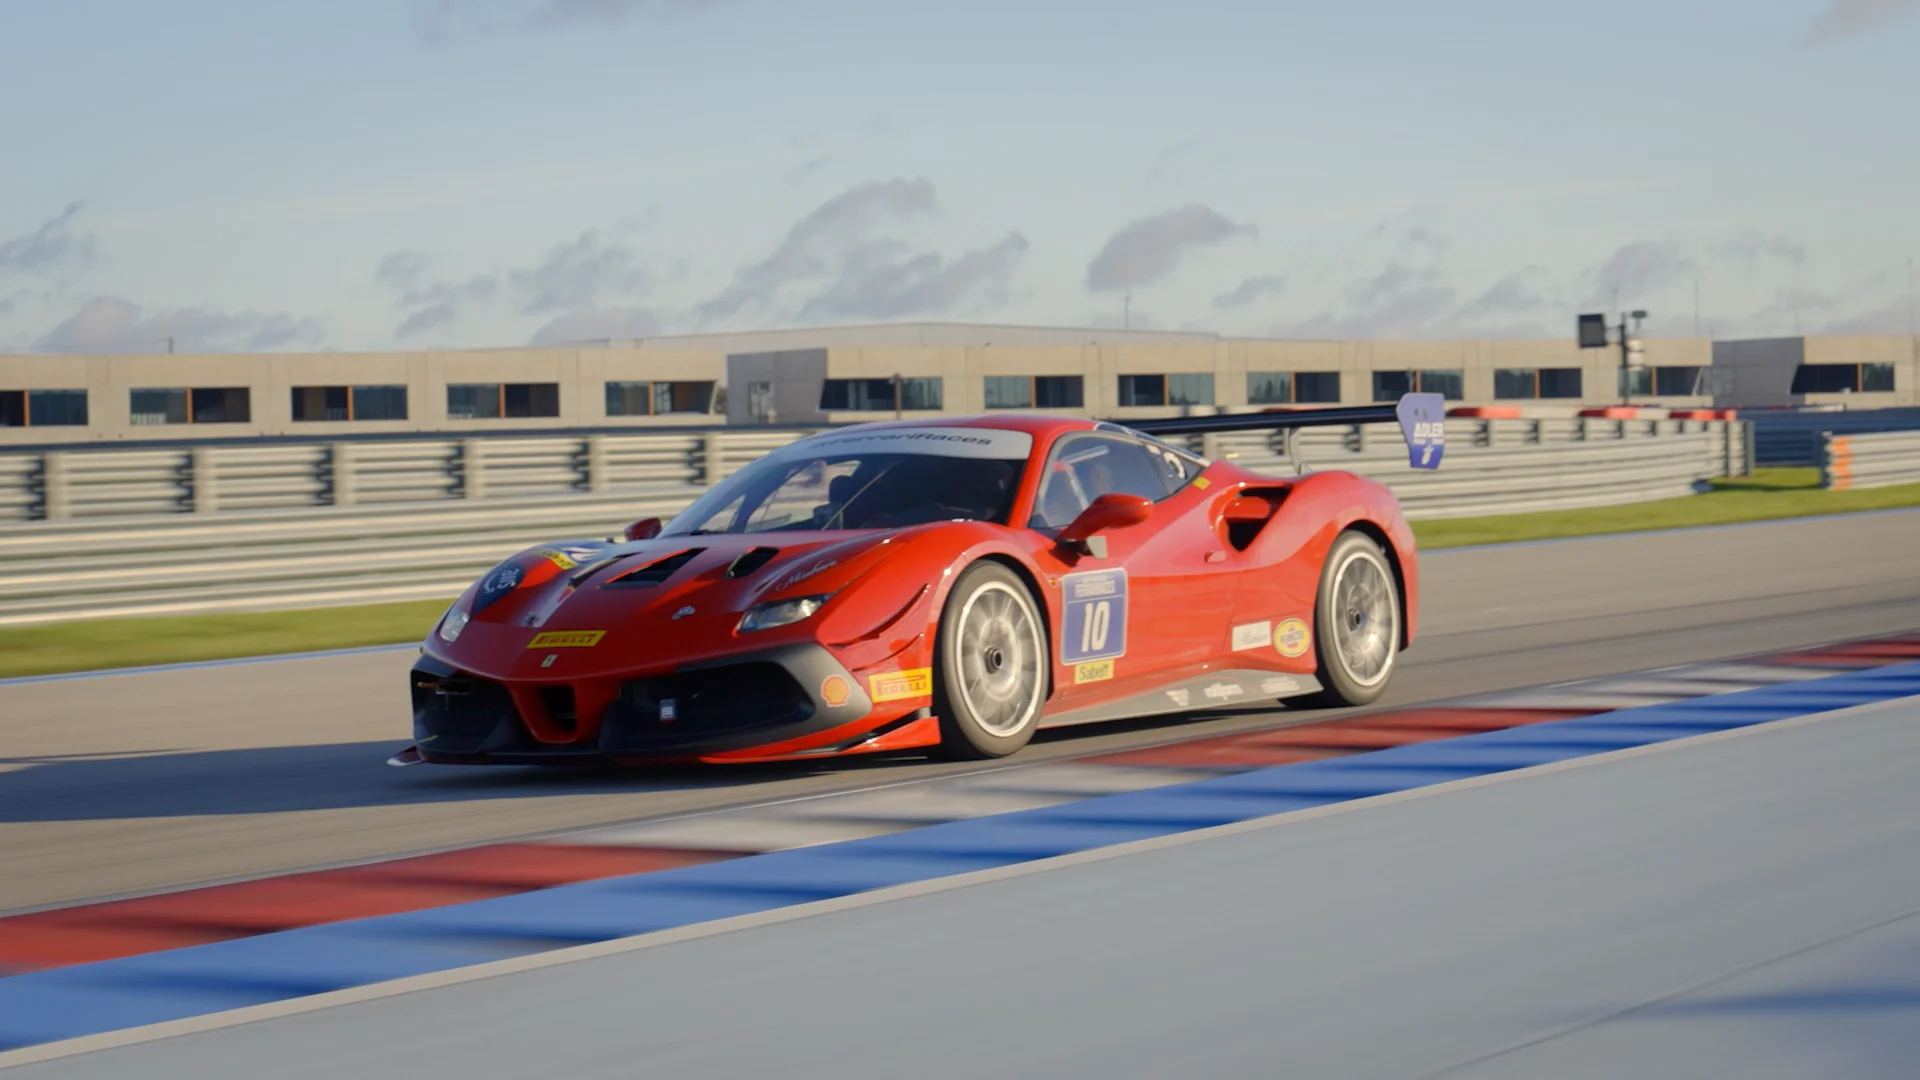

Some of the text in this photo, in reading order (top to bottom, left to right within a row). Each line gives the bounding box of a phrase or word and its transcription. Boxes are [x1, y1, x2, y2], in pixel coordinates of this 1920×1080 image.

[1081, 600, 1110, 653] 10
[535, 633, 598, 645] PIRELLI
[876, 674, 926, 696] PIRELLI
